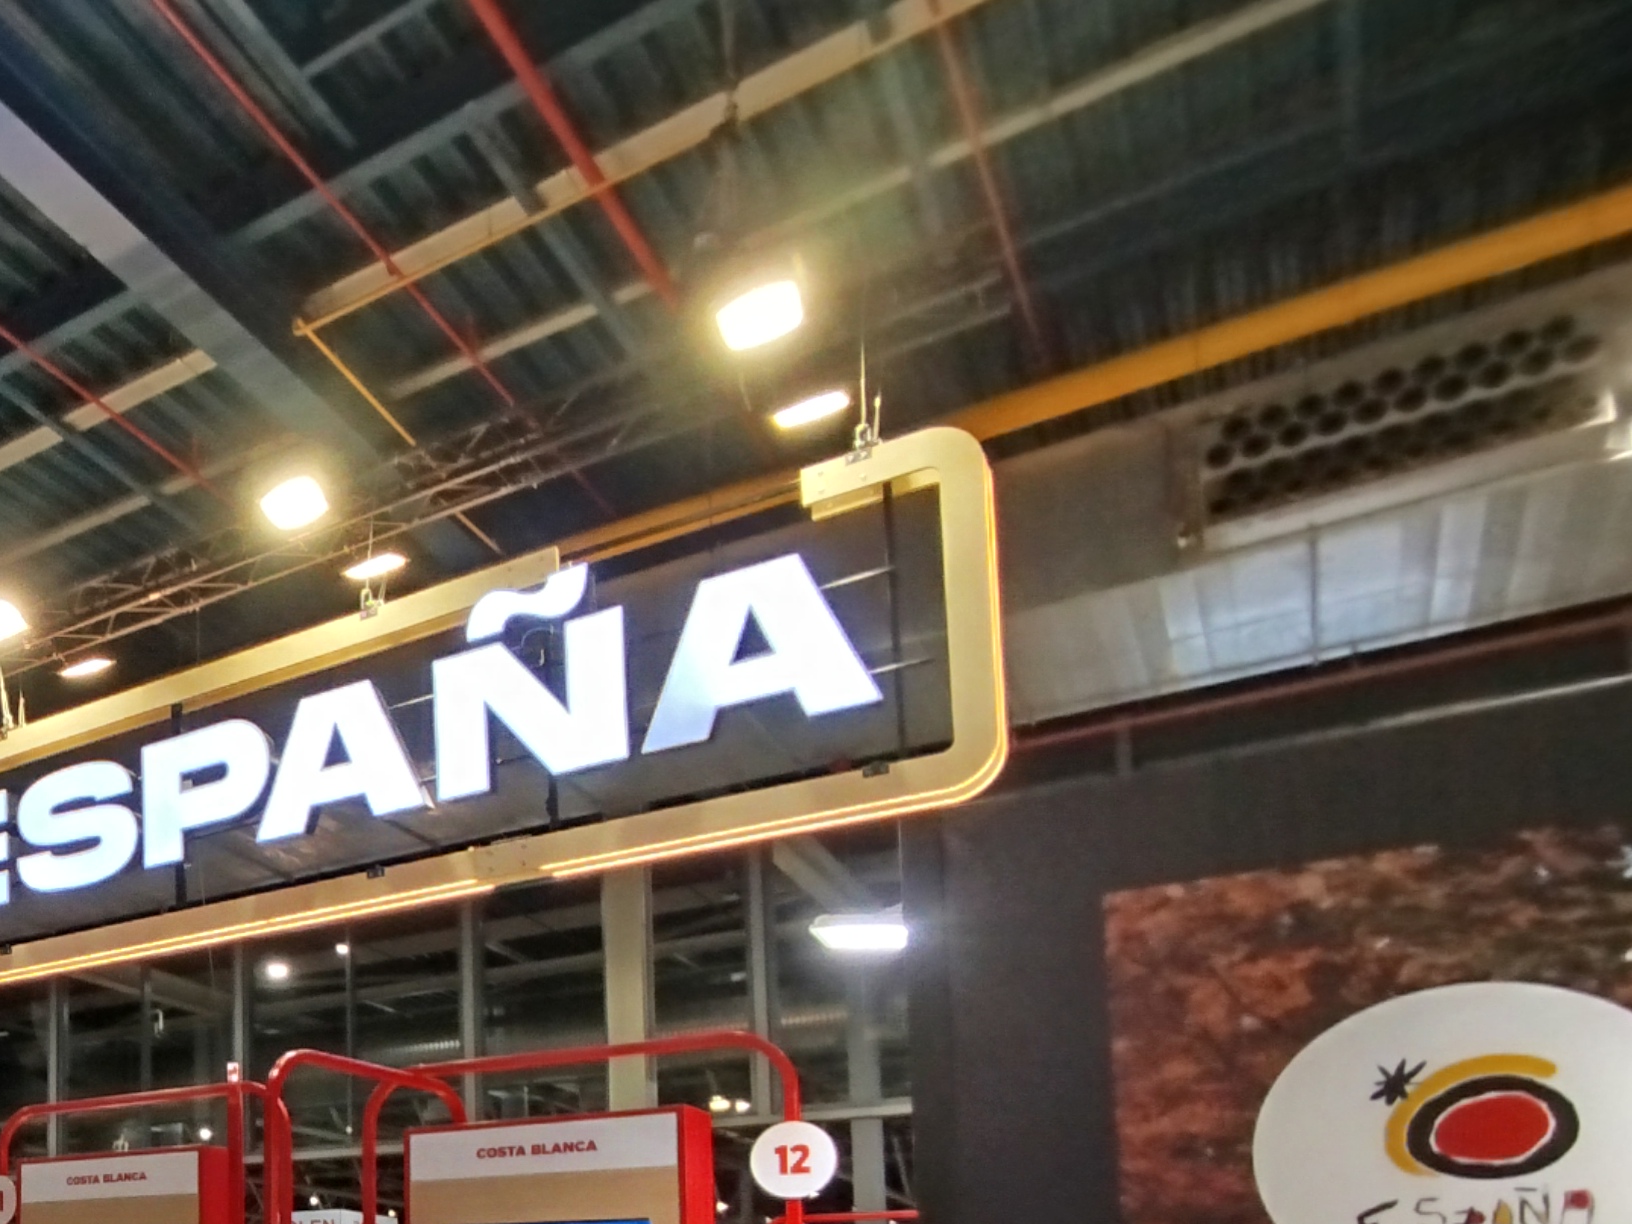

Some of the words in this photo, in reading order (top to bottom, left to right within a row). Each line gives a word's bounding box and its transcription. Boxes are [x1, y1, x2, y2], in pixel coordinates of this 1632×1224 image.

[476, 1145, 526, 1159] COSTA
[530, 1139, 598, 1155] BLANCA
[774, 1143, 811, 1175] 12
[66, 1174, 100, 1186] COSTA
[102, 1172, 147, 1183] BLANCA
